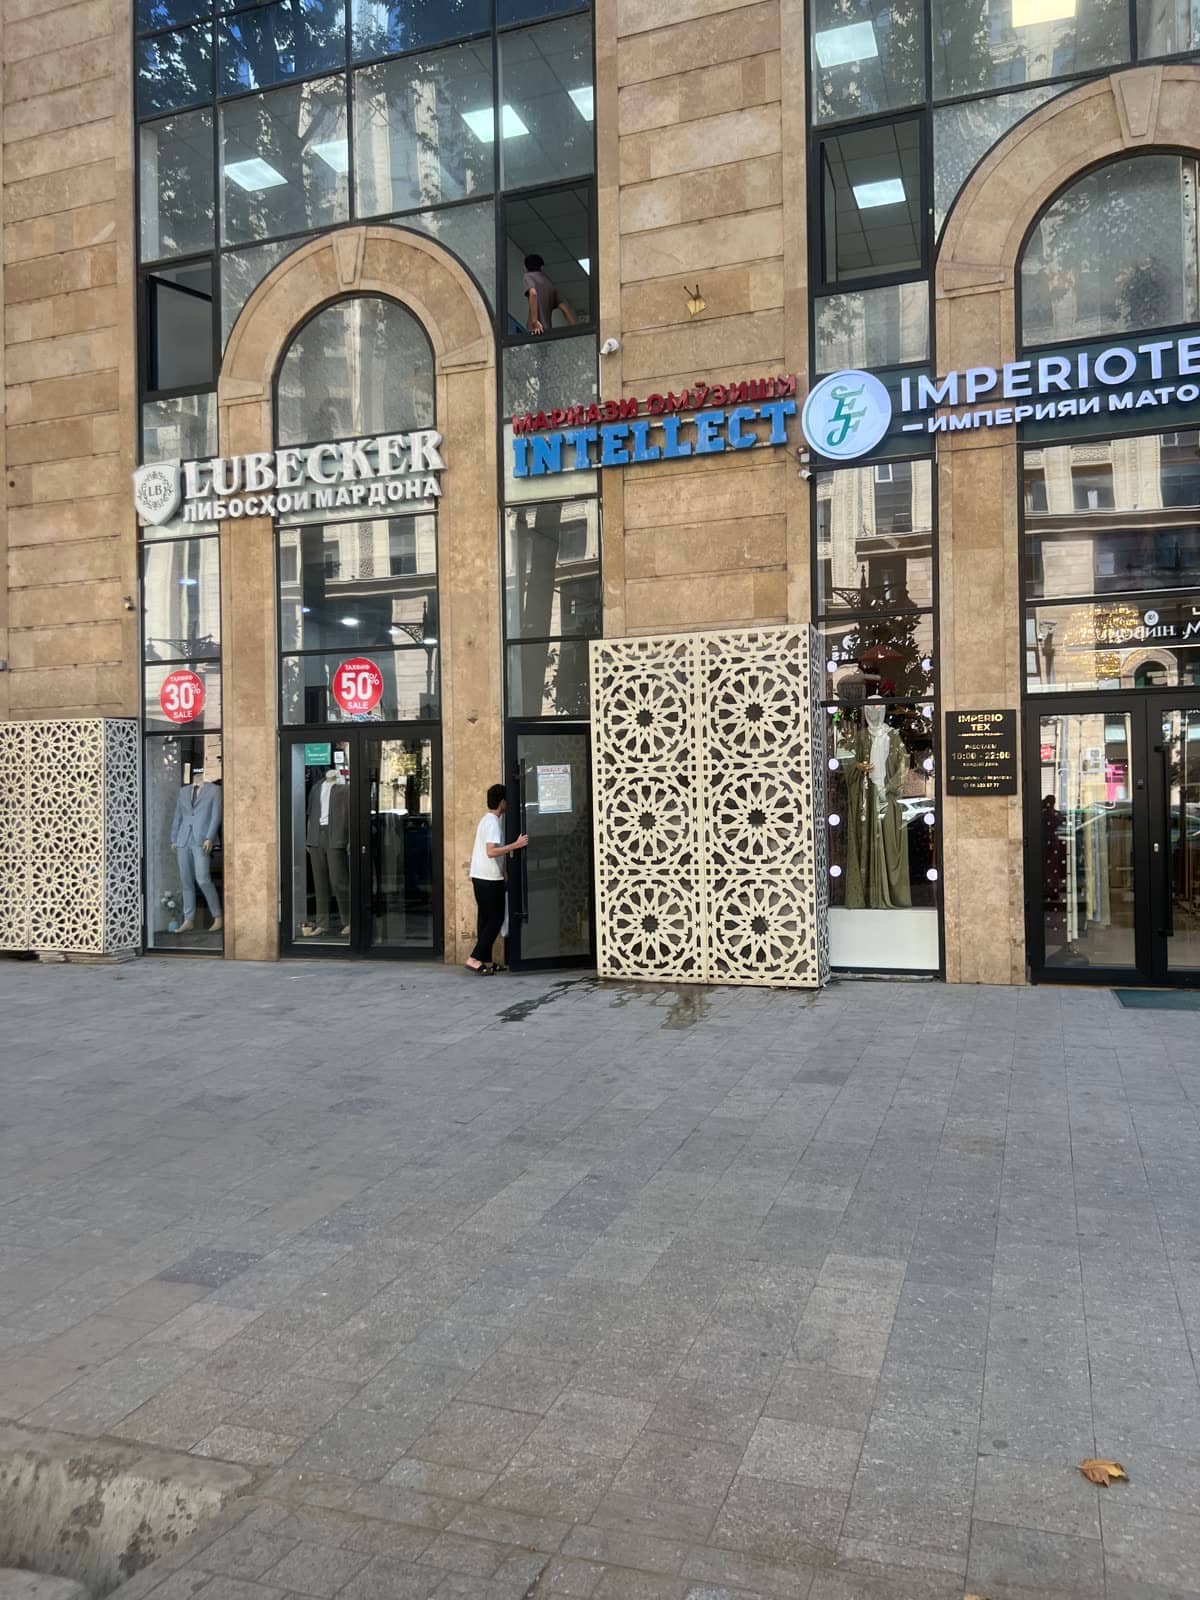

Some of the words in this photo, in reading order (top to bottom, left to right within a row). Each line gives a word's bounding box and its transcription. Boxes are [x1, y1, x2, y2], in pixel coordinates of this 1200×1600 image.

[900, 336, 1200, 412] IMPERIOTE
[1108, 384, 1200, 411] МАТО
[512, 397, 638, 435] МАРКАЗИ
[512, 398, 797, 478] INTELLECT
[183, 430, 446, 499] LUBECKER
[315, 477, 442, 509] МАРДОНА
[165, 682, 201, 711] 30%
[341, 672, 380, 700] 50%
[173, 710, 193, 719] SALE
[347, 701, 368, 710] SALE
[958, 713, 1003, 723] IMPERIO
[971, 723, 991, 732] TEX
[985, 751, 1011, 760] 22:00
